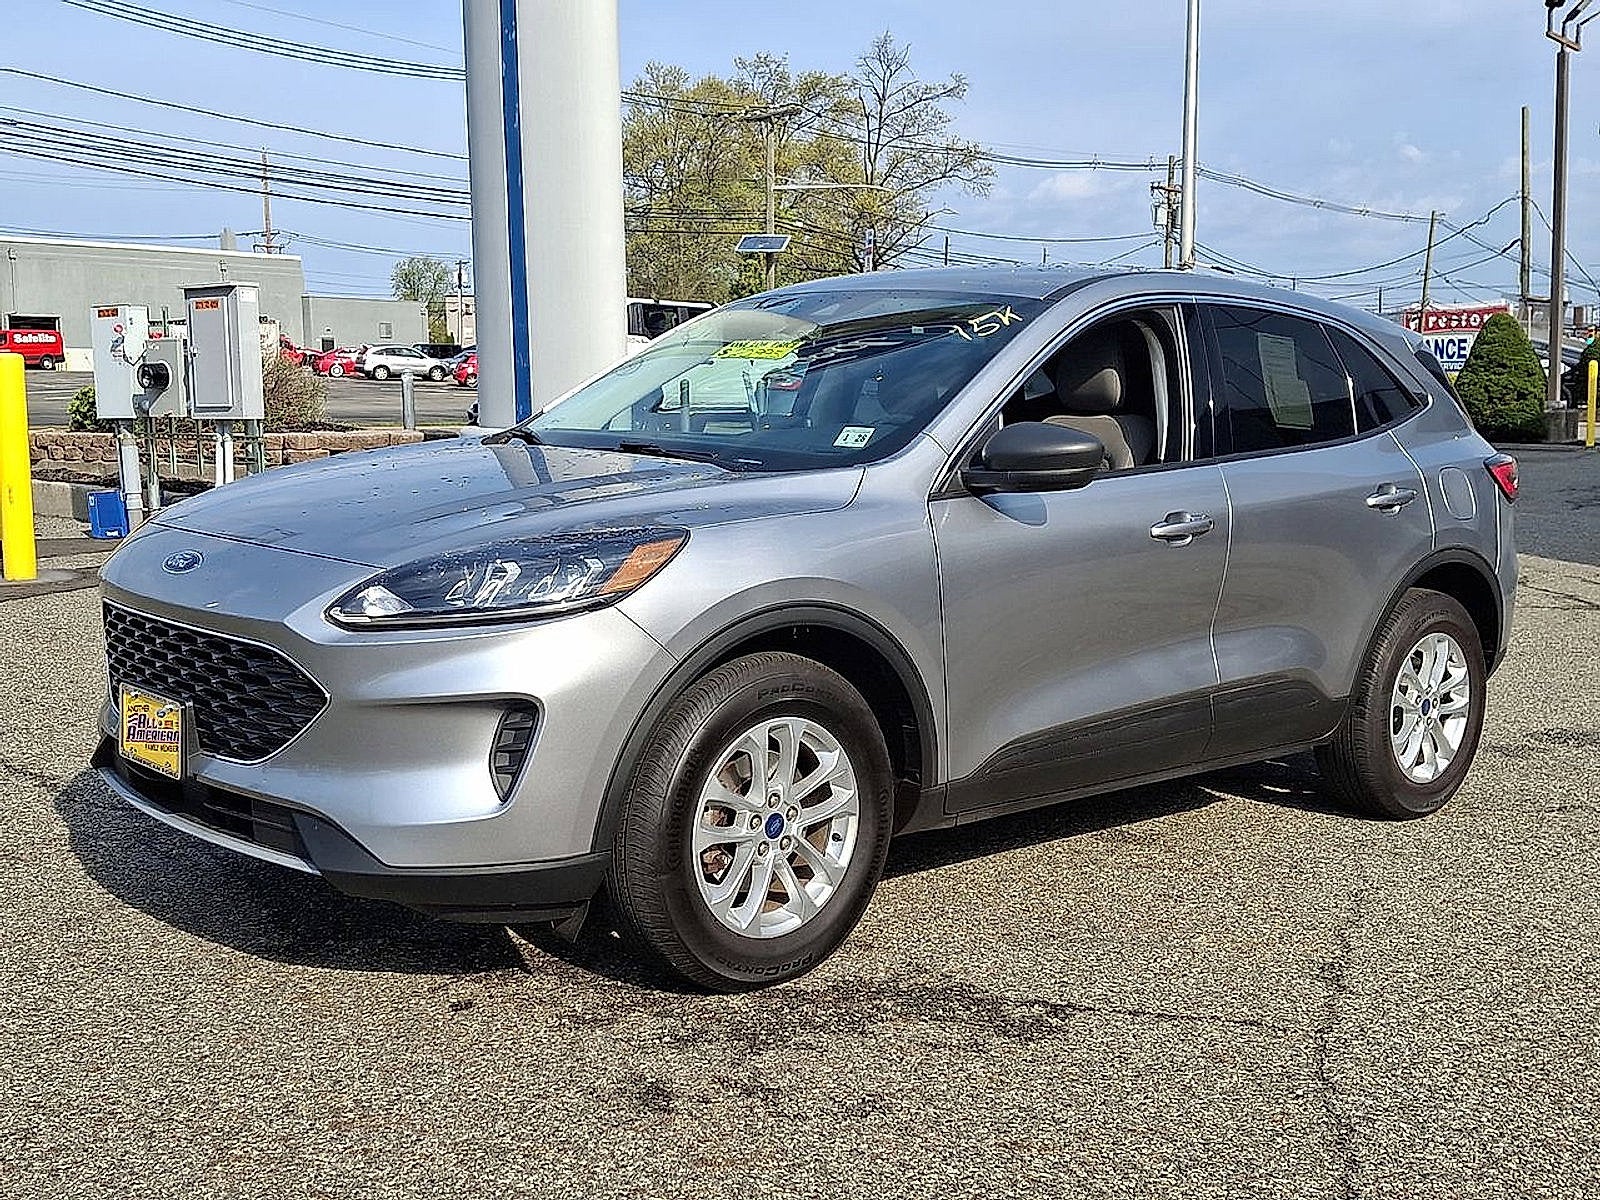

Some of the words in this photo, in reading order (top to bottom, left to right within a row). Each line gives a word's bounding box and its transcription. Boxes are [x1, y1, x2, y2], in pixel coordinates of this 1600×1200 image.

[13, 332, 57, 344] Safelite
[138, 714, 158, 729] ALL
[127, 726, 180, 742] AMERICAN
